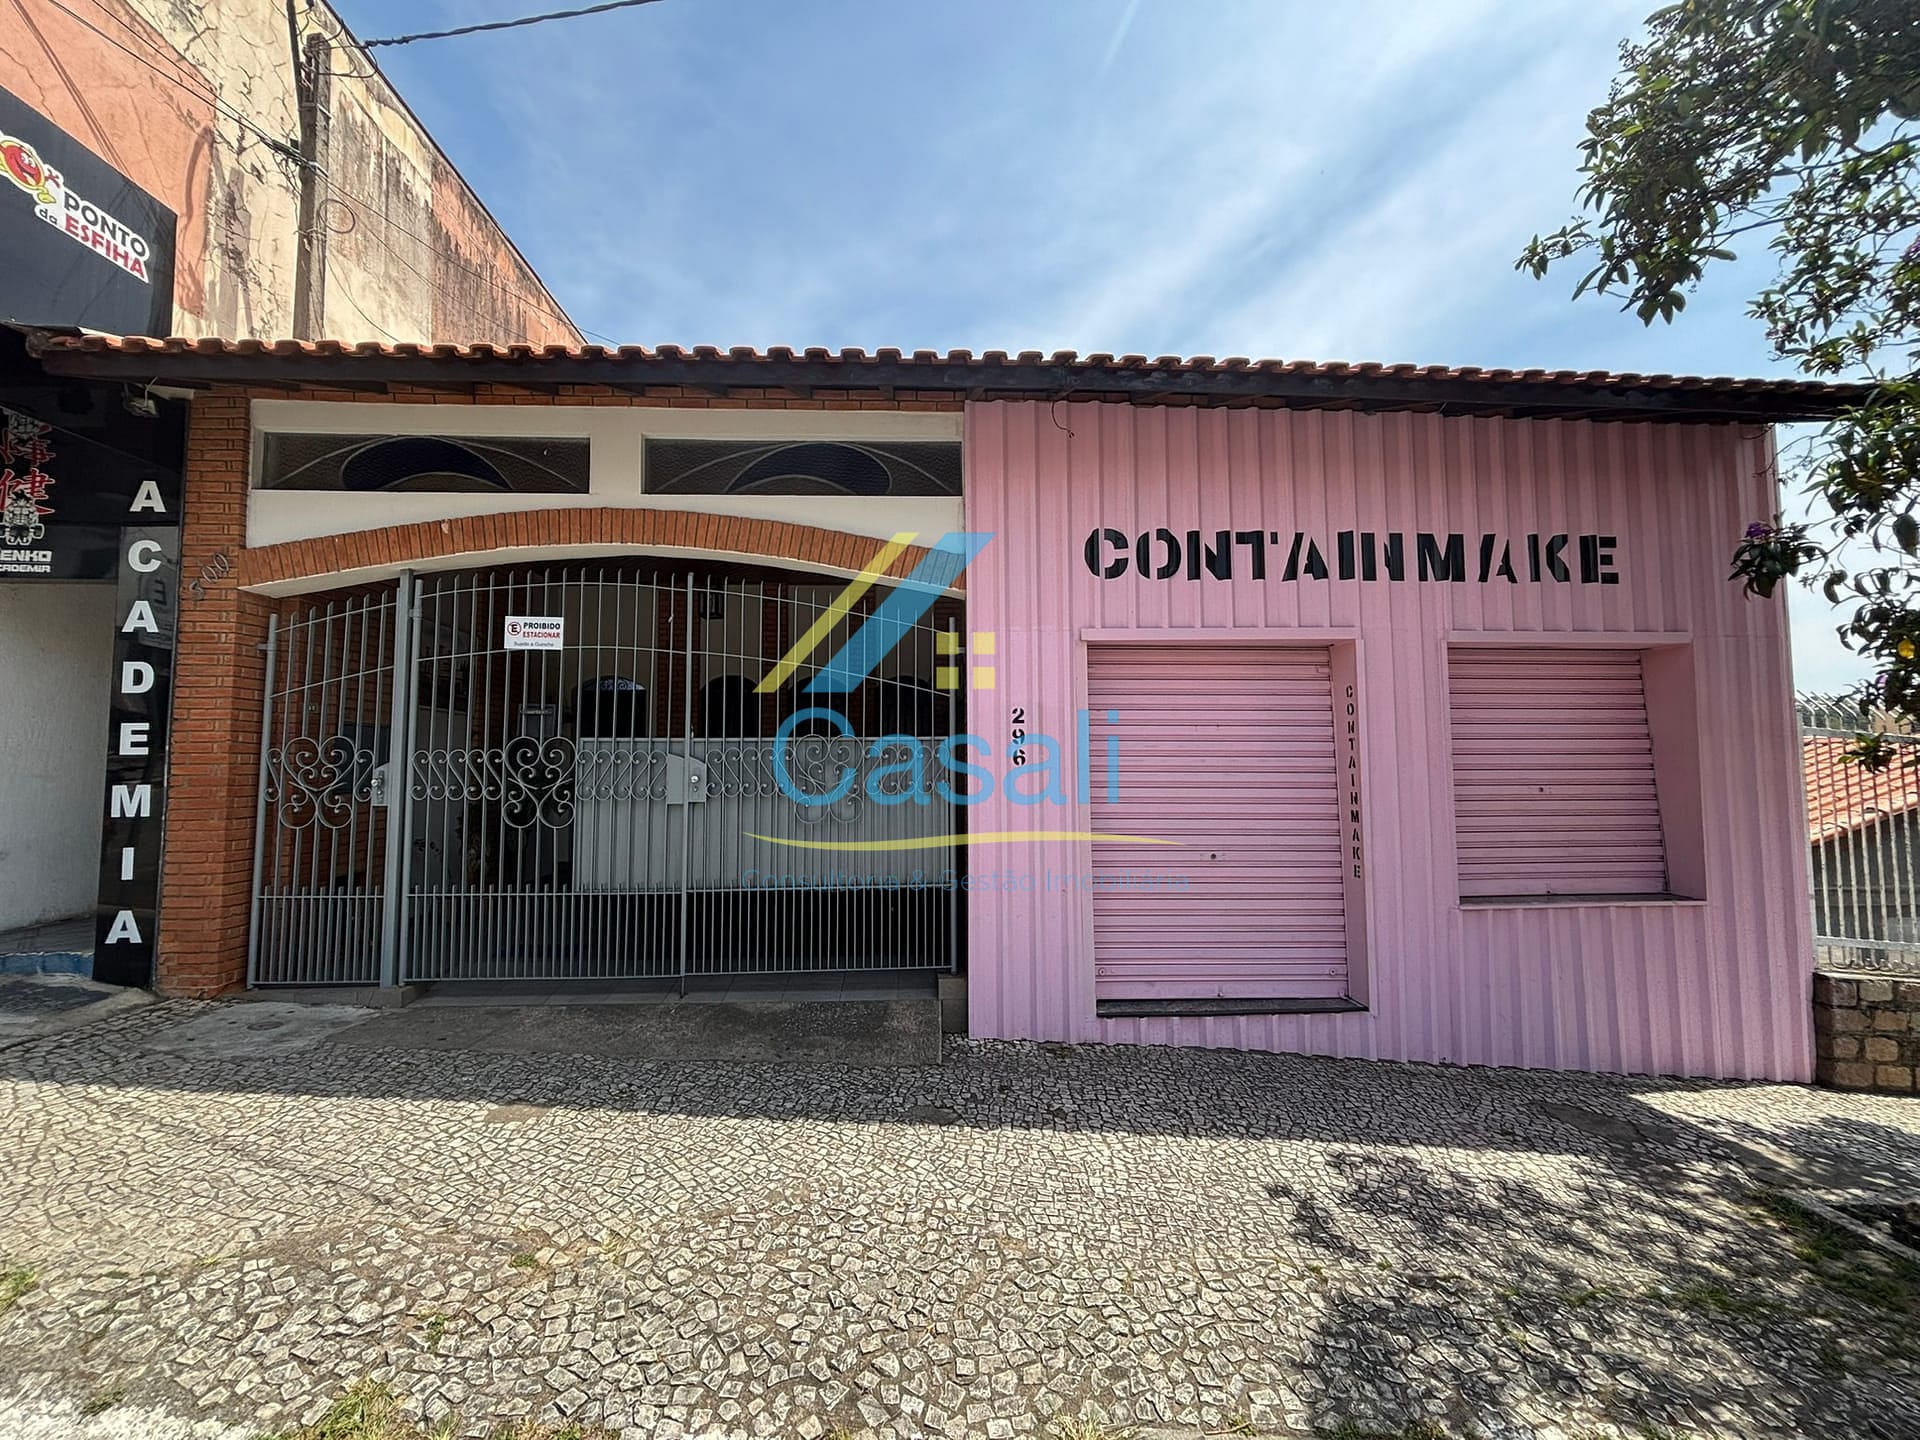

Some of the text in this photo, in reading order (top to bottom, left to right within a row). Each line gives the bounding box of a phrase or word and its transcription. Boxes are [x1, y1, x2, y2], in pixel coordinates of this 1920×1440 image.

[39, 208, 145, 279] da ESFIHA
[64, 191, 146, 258] PONTO
[0, 550, 52, 562] ENKO
[0, 564, 51, 573] ADEMIA
[1083, 527, 1620, 585] CONTAINMAKE
[523, 622, 560, 630] PROIBIDO
[104, 480, 167, 945] ACADEMIA
[1012, 707, 1026, 766] 296
[1345, 684, 1361, 879] CONTAINMAKE
